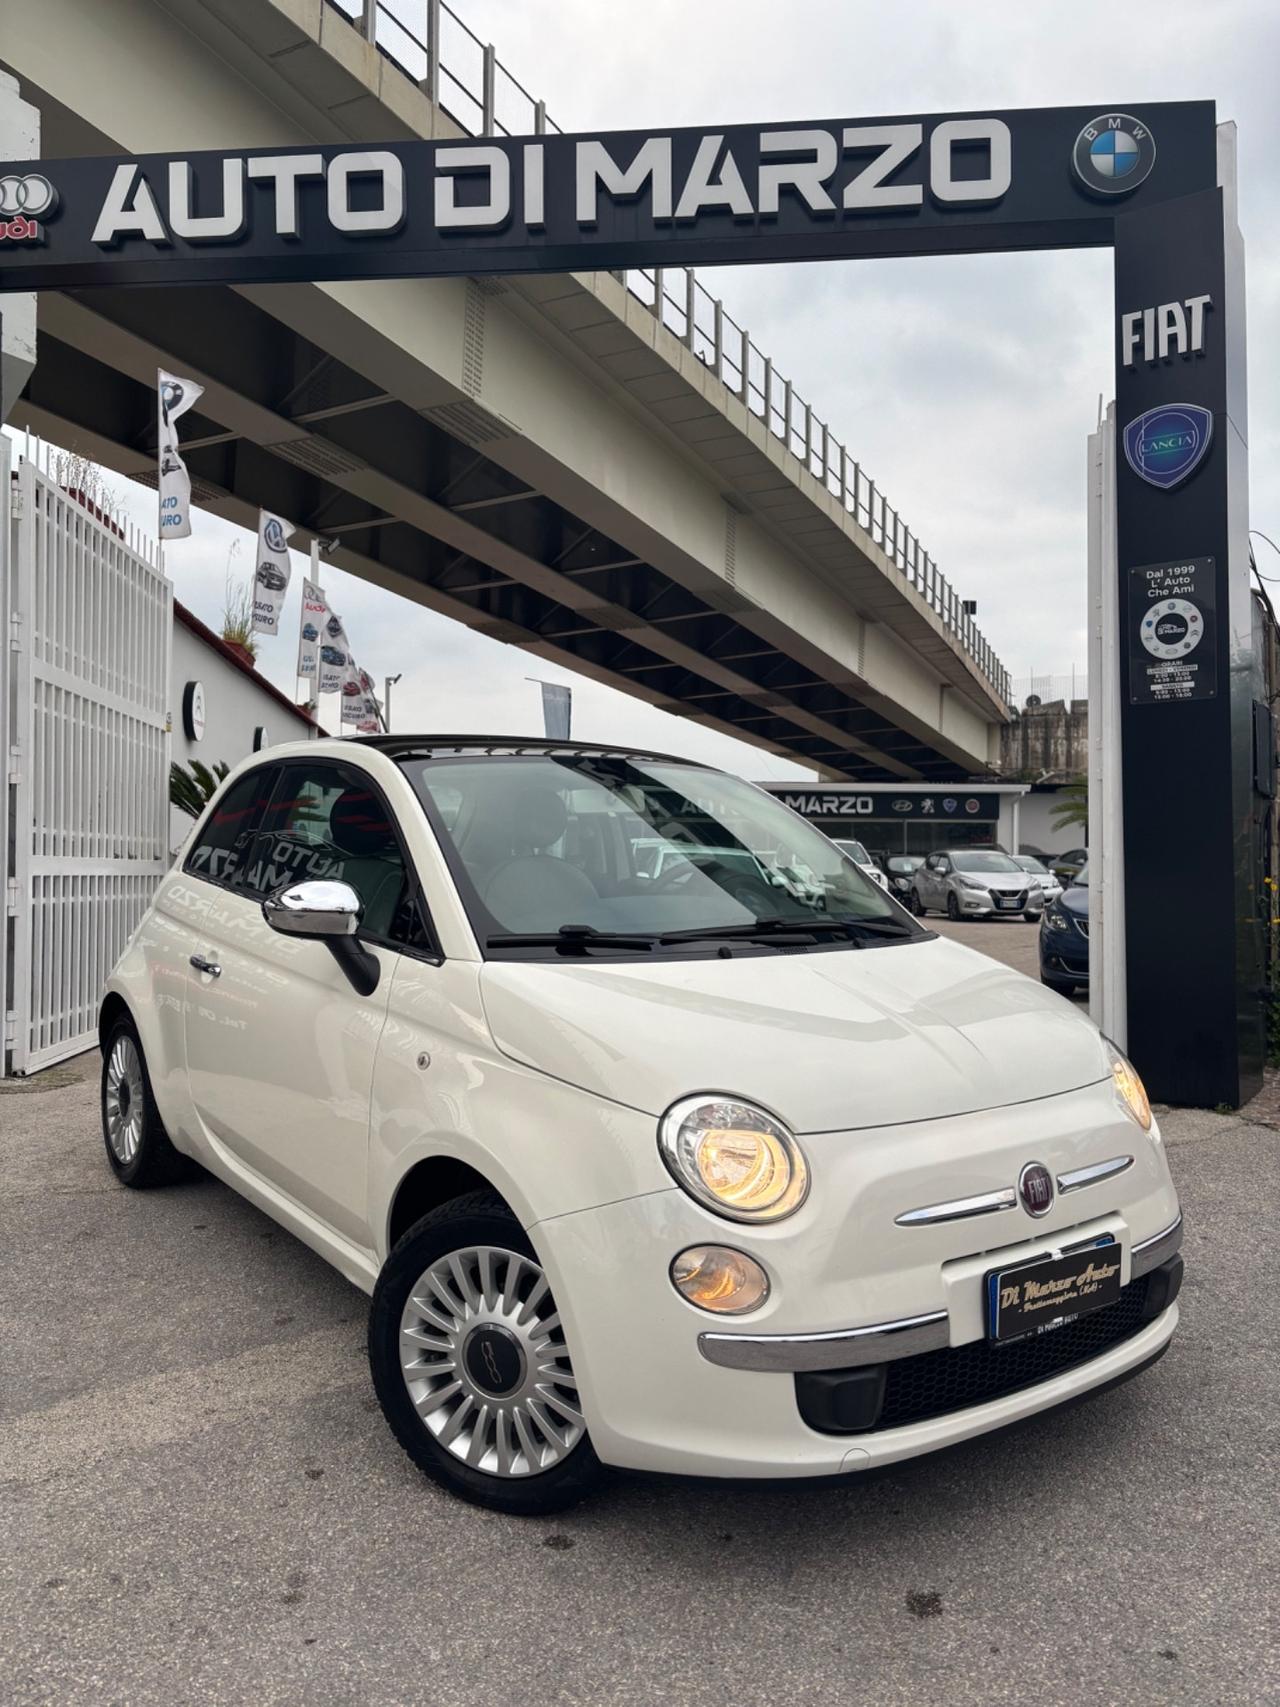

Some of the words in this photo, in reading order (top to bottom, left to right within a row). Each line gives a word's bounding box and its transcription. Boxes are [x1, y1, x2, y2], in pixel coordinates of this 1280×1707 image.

[1084, 118, 1147, 141] BMW
[91, 151, 403, 242] AUTO
[434, 144, 544, 228] DI
[575, 118, 1012, 222] MARZO
[1121, 294, 1211, 366] FIAT
[1142, 434, 1193, 453] LANCIA
[1146, 569, 1164, 579] Dal
[1168, 565, 1195, 576] 1999
[1164, 577, 1191, 586] Auto
[1147, 588, 1169, 598] Che
[784, 795, 874, 814] MARZO
[1028, 1177, 1048, 1204] FIAT
